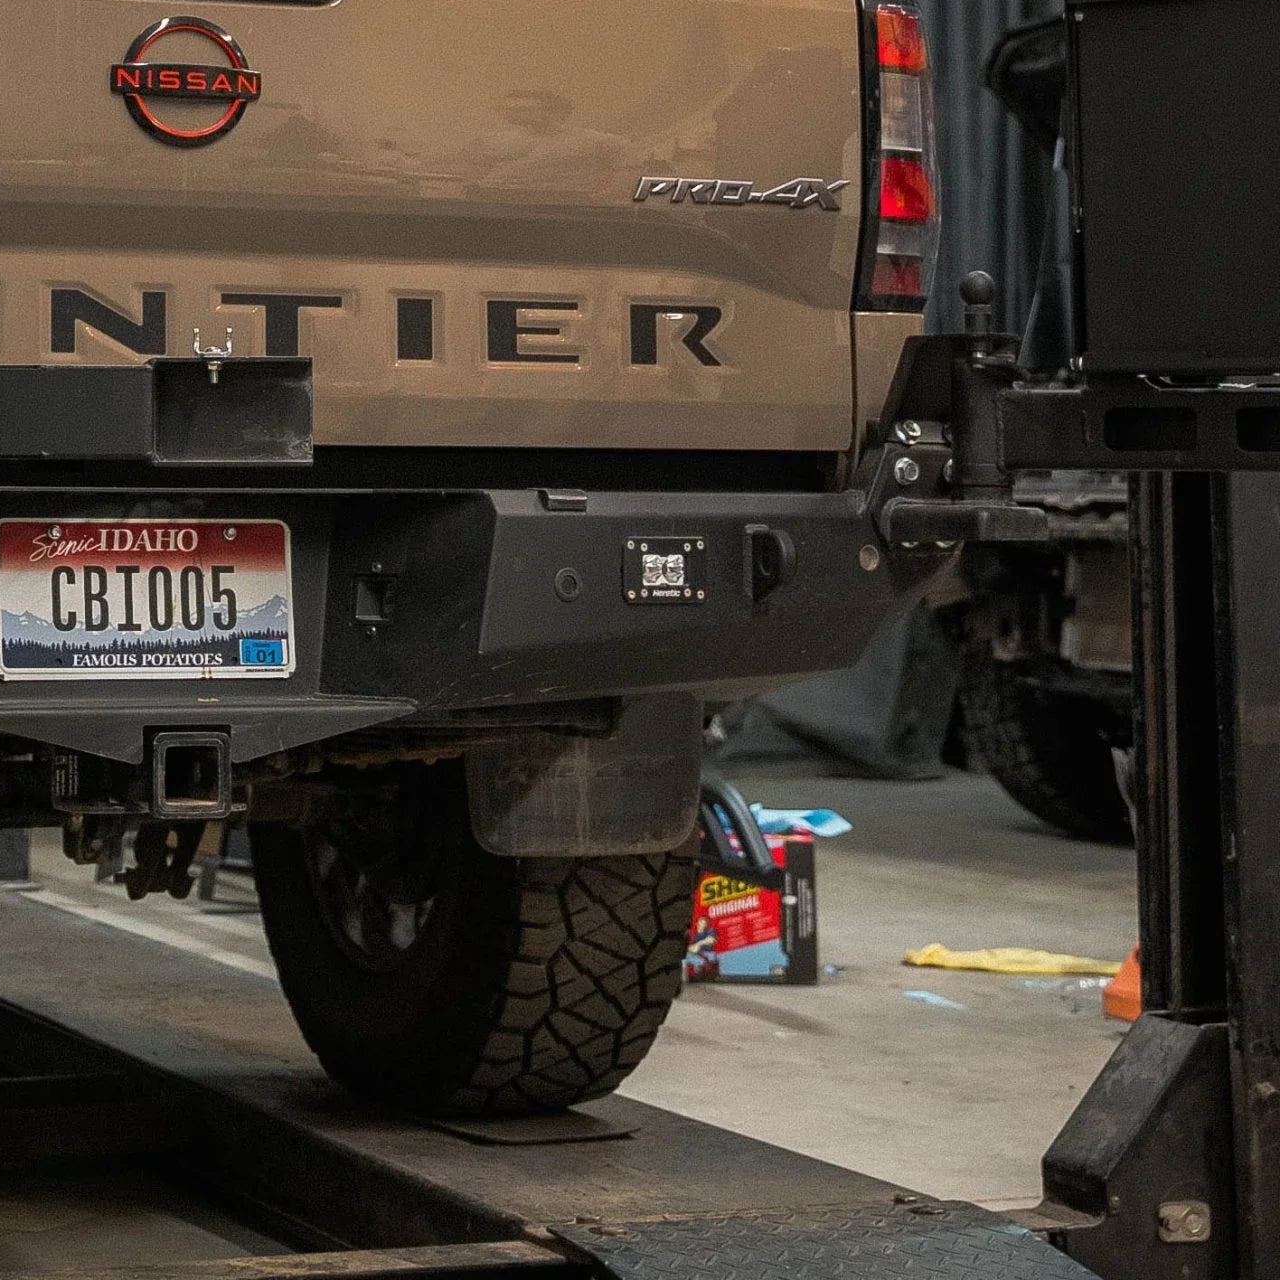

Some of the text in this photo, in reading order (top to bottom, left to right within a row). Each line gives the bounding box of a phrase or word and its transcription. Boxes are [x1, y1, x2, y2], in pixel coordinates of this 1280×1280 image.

[116, 67, 257, 95] NISSAN
[632, 176, 851, 211] PRO-4X
[29, 528, 199, 562] Scenic IDAHO
[72, 652, 223, 667] FAMOUS POTATOES
[256, 649, 276, 663] 01
[704, 877, 758, 901] SHO
[708, 894, 759, 918] ORIGINAL
